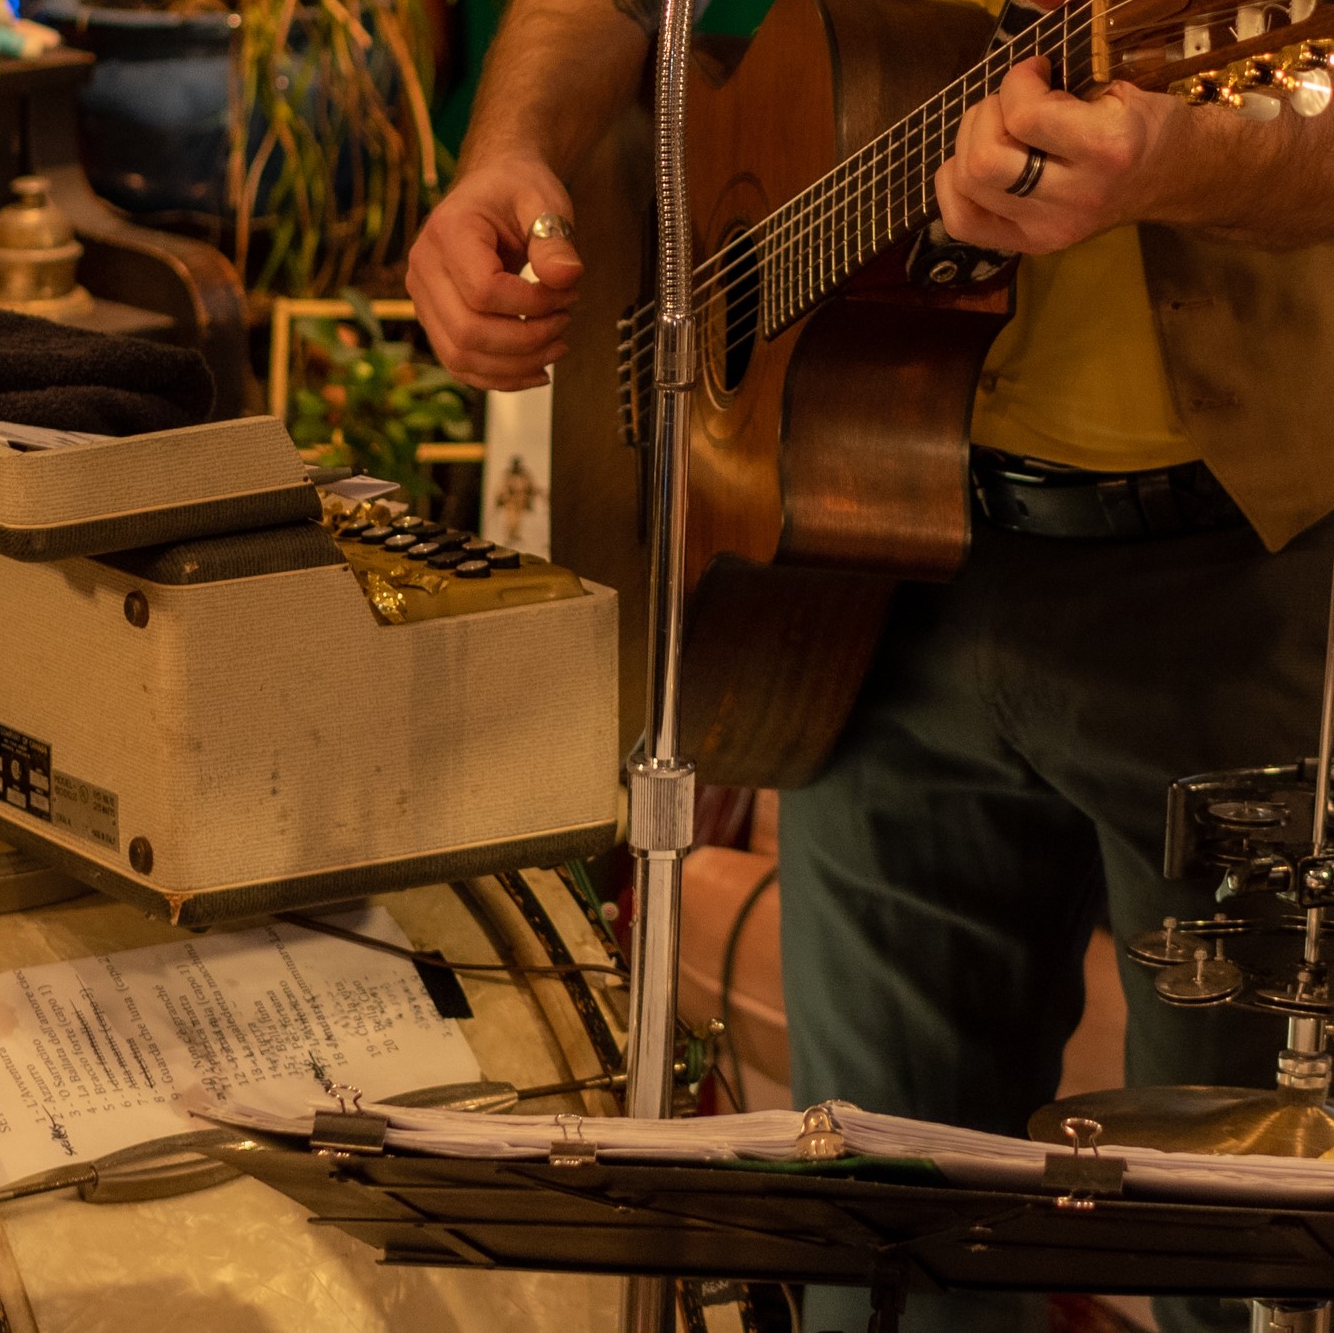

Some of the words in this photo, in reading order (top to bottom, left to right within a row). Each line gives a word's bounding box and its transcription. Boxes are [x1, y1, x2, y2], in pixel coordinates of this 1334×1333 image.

[24, 991, 60, 1045] dell'amore
[47, 997, 72, 1027] (capo
[123, 997, 141, 1021] luna
[365, 1004, 386, 1031] Bella
[137, 1022, 152, 1041] che
[352, 1015, 369, 1036] Che
[64, 1027, 84, 1055] forte
[32, 1039, 65, 1087] Sarracino
[54, 1047, 81, 1082] Ballata
[78, 1057, 106, 1094] Braccio
[146, 1043, 173, 1083] Guarda
[25, 1064, 55, 1104] Azzurro
[76, 1084, 89, 1097] La
